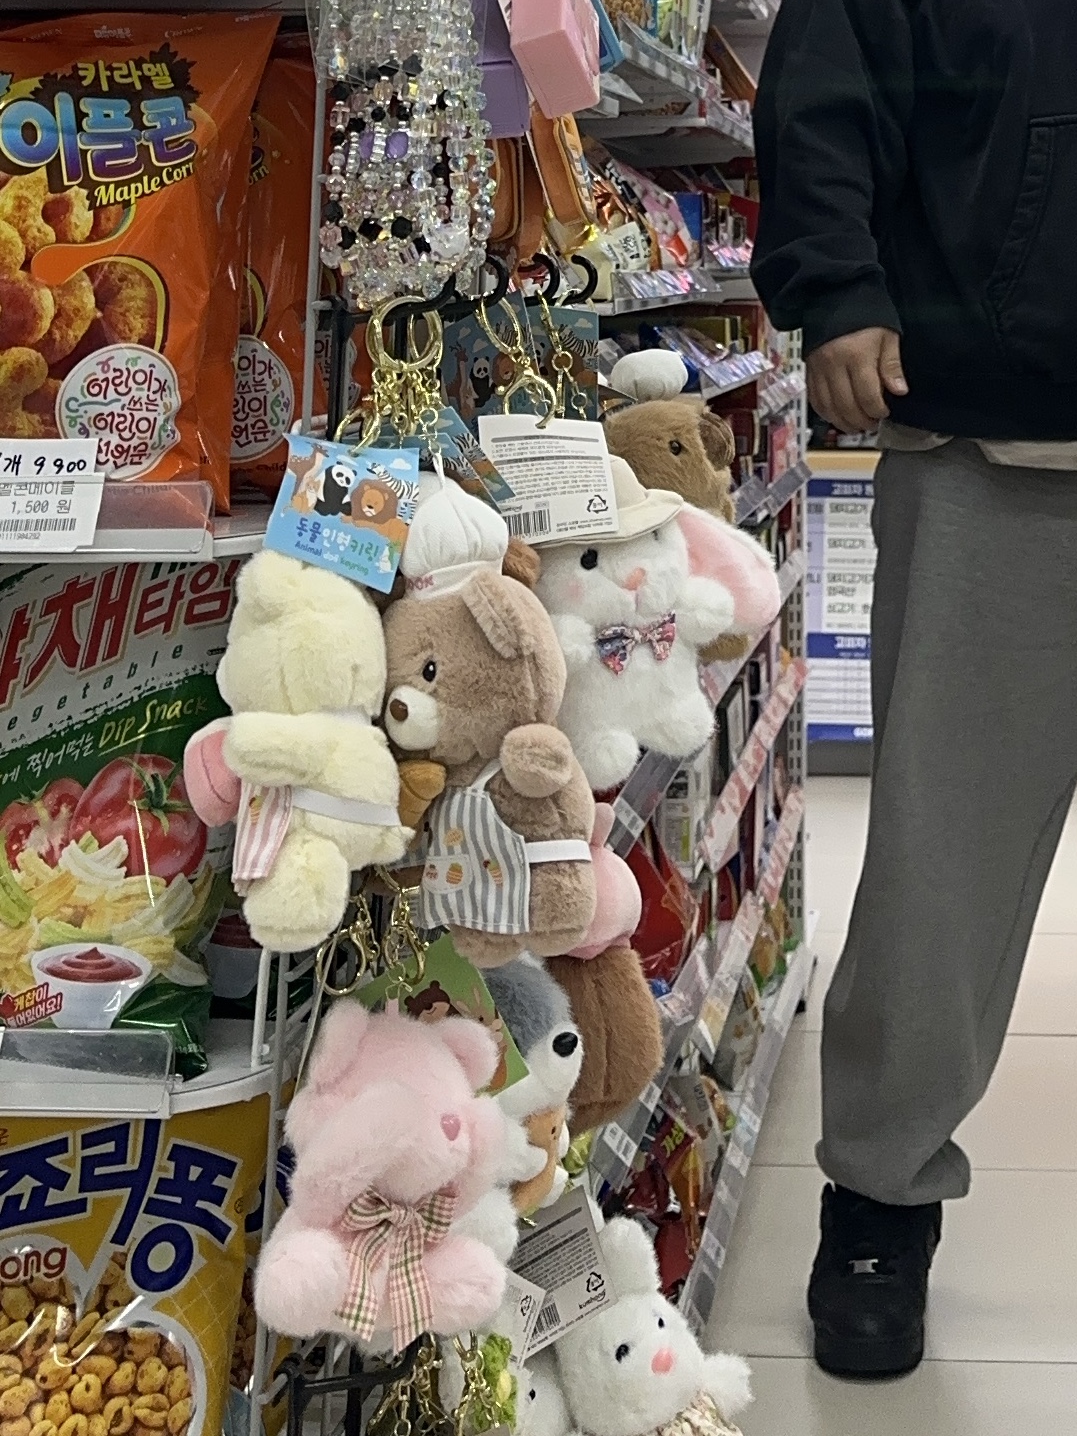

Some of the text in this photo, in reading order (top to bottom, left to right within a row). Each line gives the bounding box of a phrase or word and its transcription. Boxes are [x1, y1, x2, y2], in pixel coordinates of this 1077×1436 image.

[77, 60, 175, 92] 카라멜
[0, 91, 198, 187] 이플콘
[95, 170, 162, 208] Maple
[87, 364, 167, 400] 어린이가
[92, 412, 158, 441] 어린이
[11, 499, 71, 515] 1,500 원
[7, 644, 184, 731] egetable
[98, 715, 136, 749] Dip
[138, 695, 208, 733] Snack
[0, 1247, 68, 1282] ong
